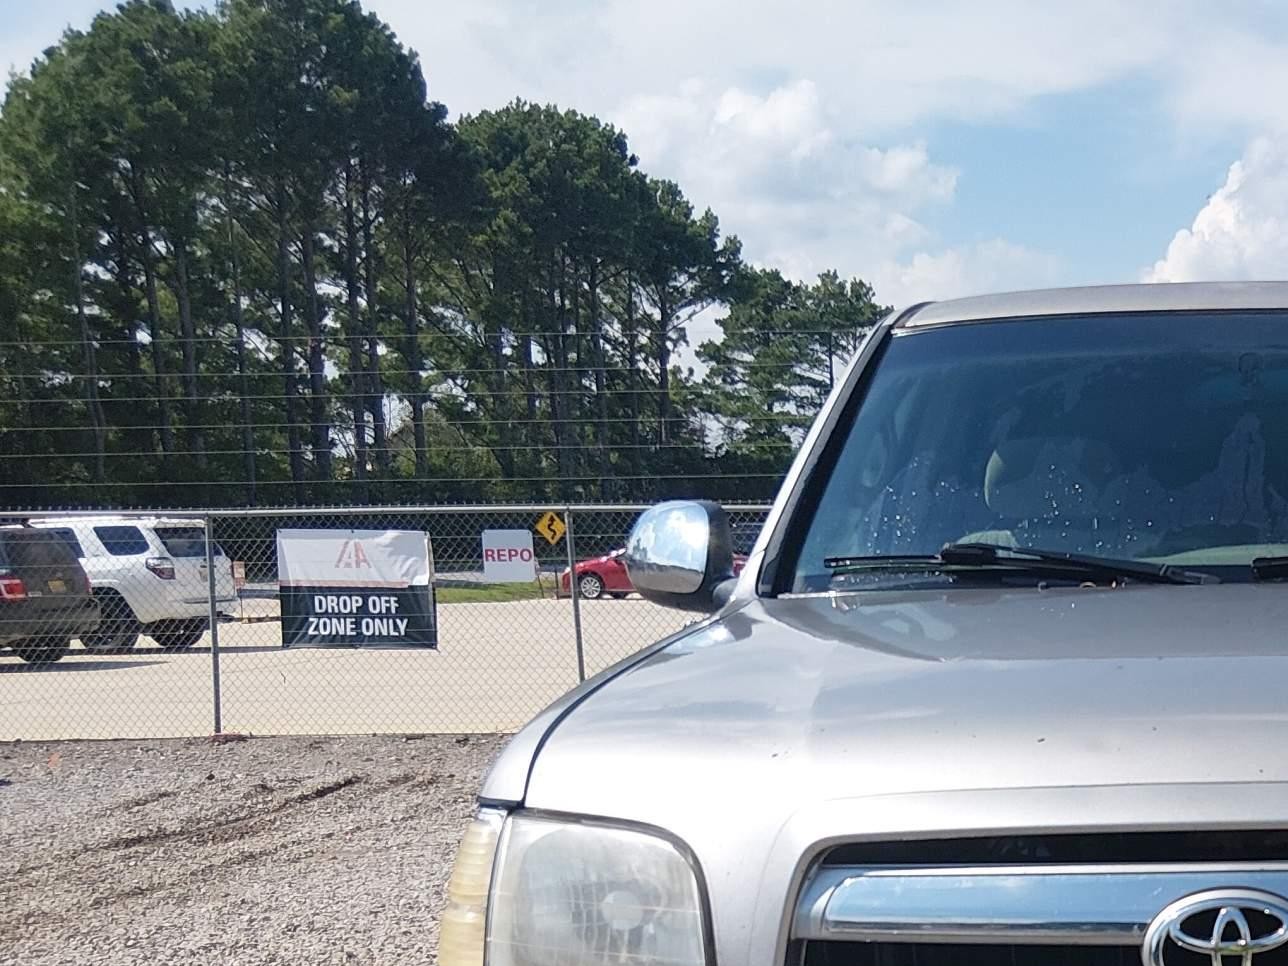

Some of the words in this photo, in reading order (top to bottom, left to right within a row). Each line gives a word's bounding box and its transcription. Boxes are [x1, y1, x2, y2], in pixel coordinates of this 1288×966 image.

[484, 548, 533, 562] REPO
[314, 595, 363, 614] DROP
[368, 595, 399, 614] OFF
[308, 617, 356, 636] ZONE
[361, 617, 408, 636] ONLY
